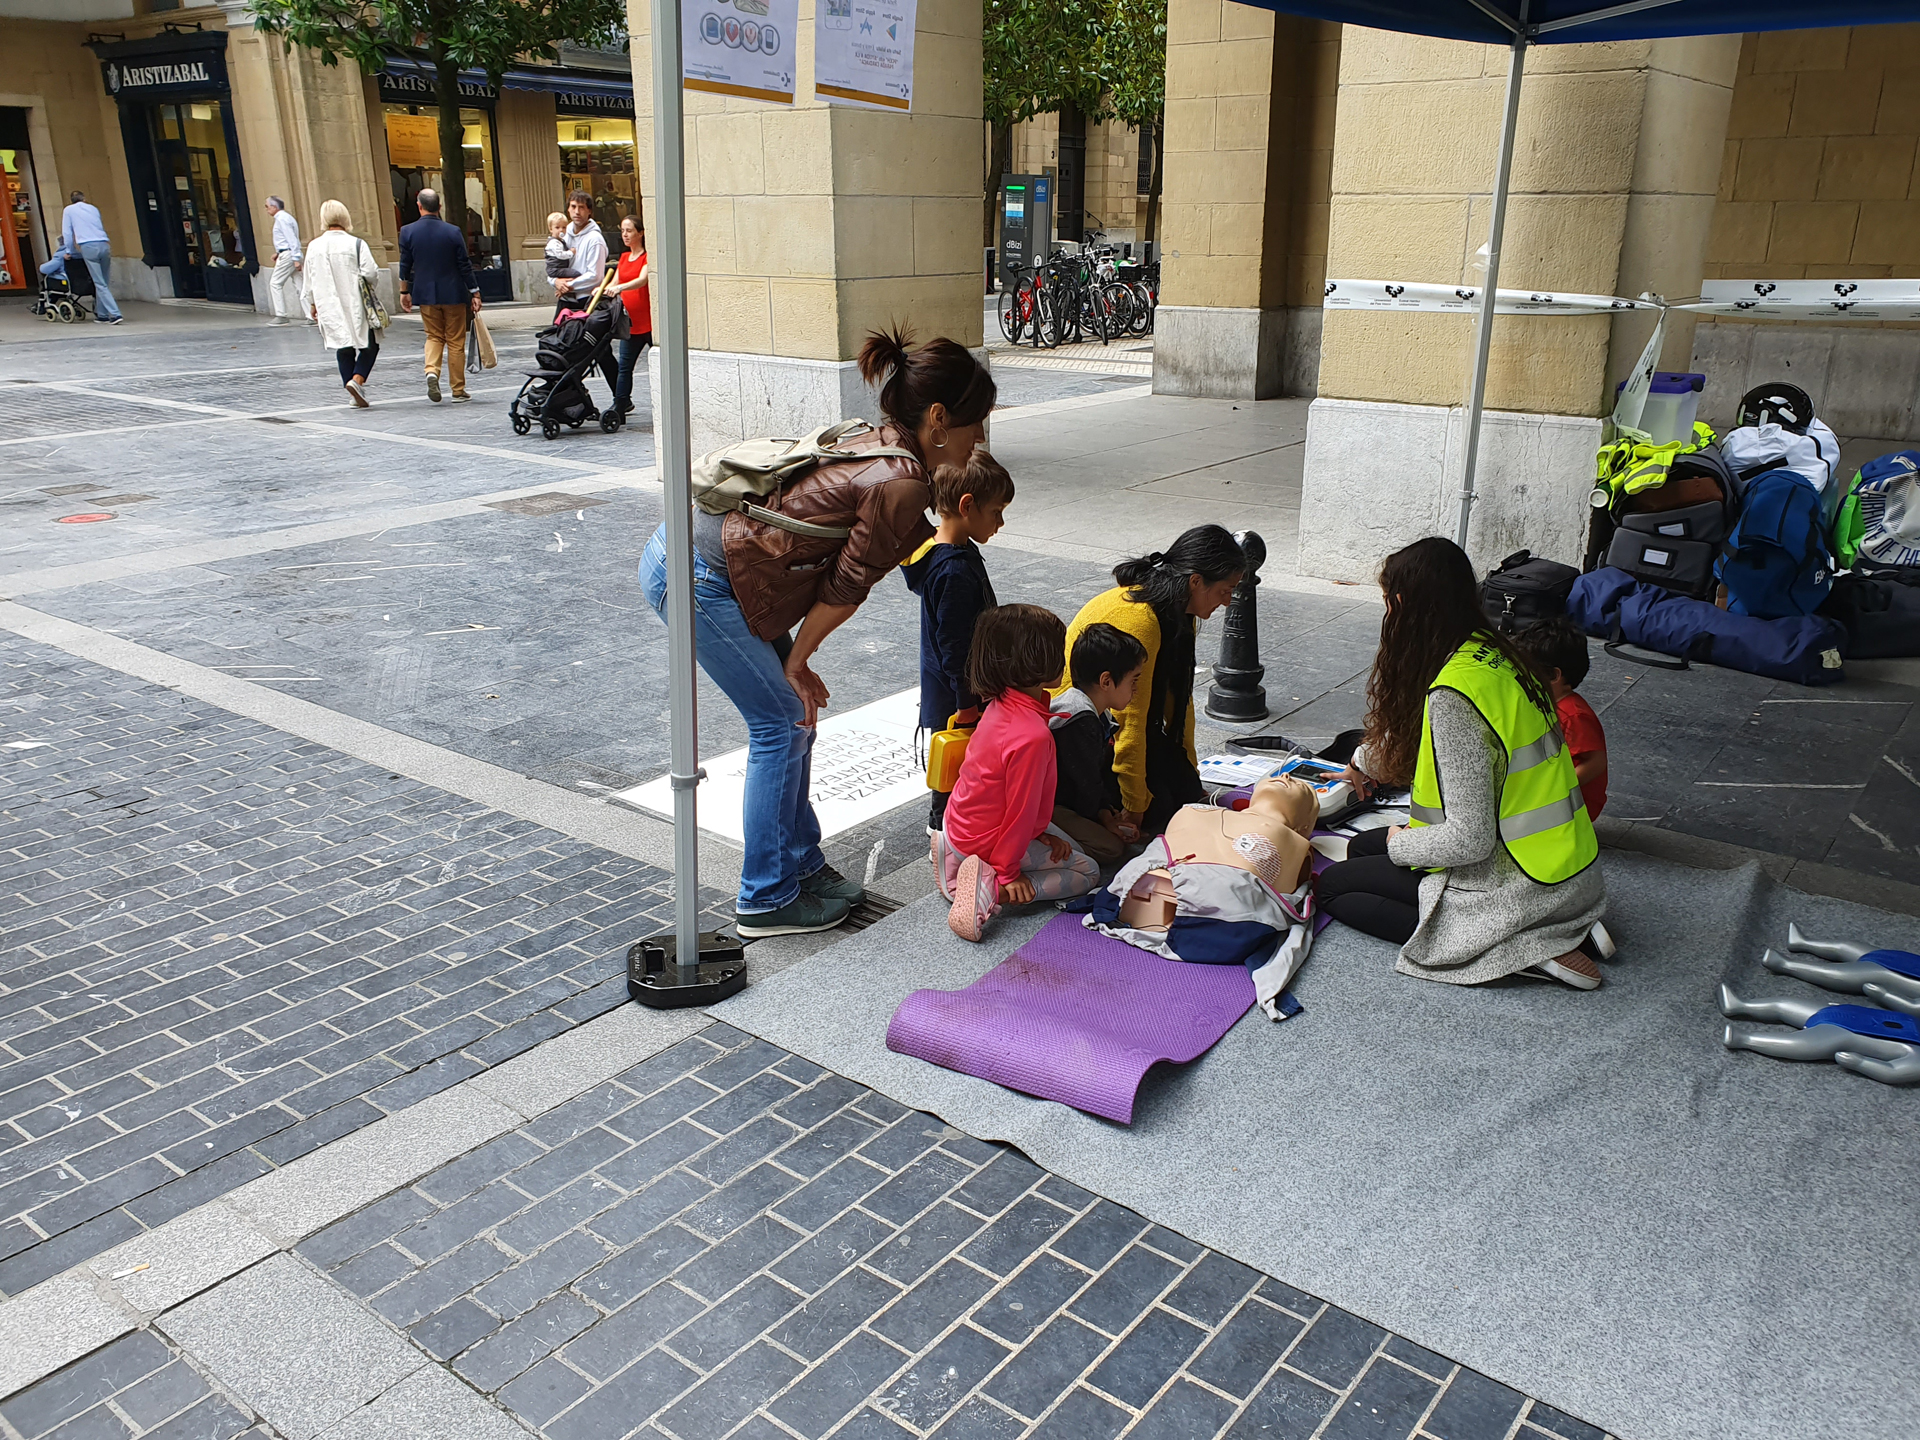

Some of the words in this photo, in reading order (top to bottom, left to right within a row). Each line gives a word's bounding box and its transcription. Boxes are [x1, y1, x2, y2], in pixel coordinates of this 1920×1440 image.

[122, 62, 210, 87] ARISTIZABAL
[558, 94, 634, 110] ARISTIZAB
[1006, 240, 1022, 250] dBizi
[1872, 538, 1900, 558] OF
[849, 732, 880, 745] DE
[811, 738, 898, 772] FACULTAD
[811, 744, 920, 786] FAKULTATEA
[808, 763, 906, 806] ERIZAINTZ
